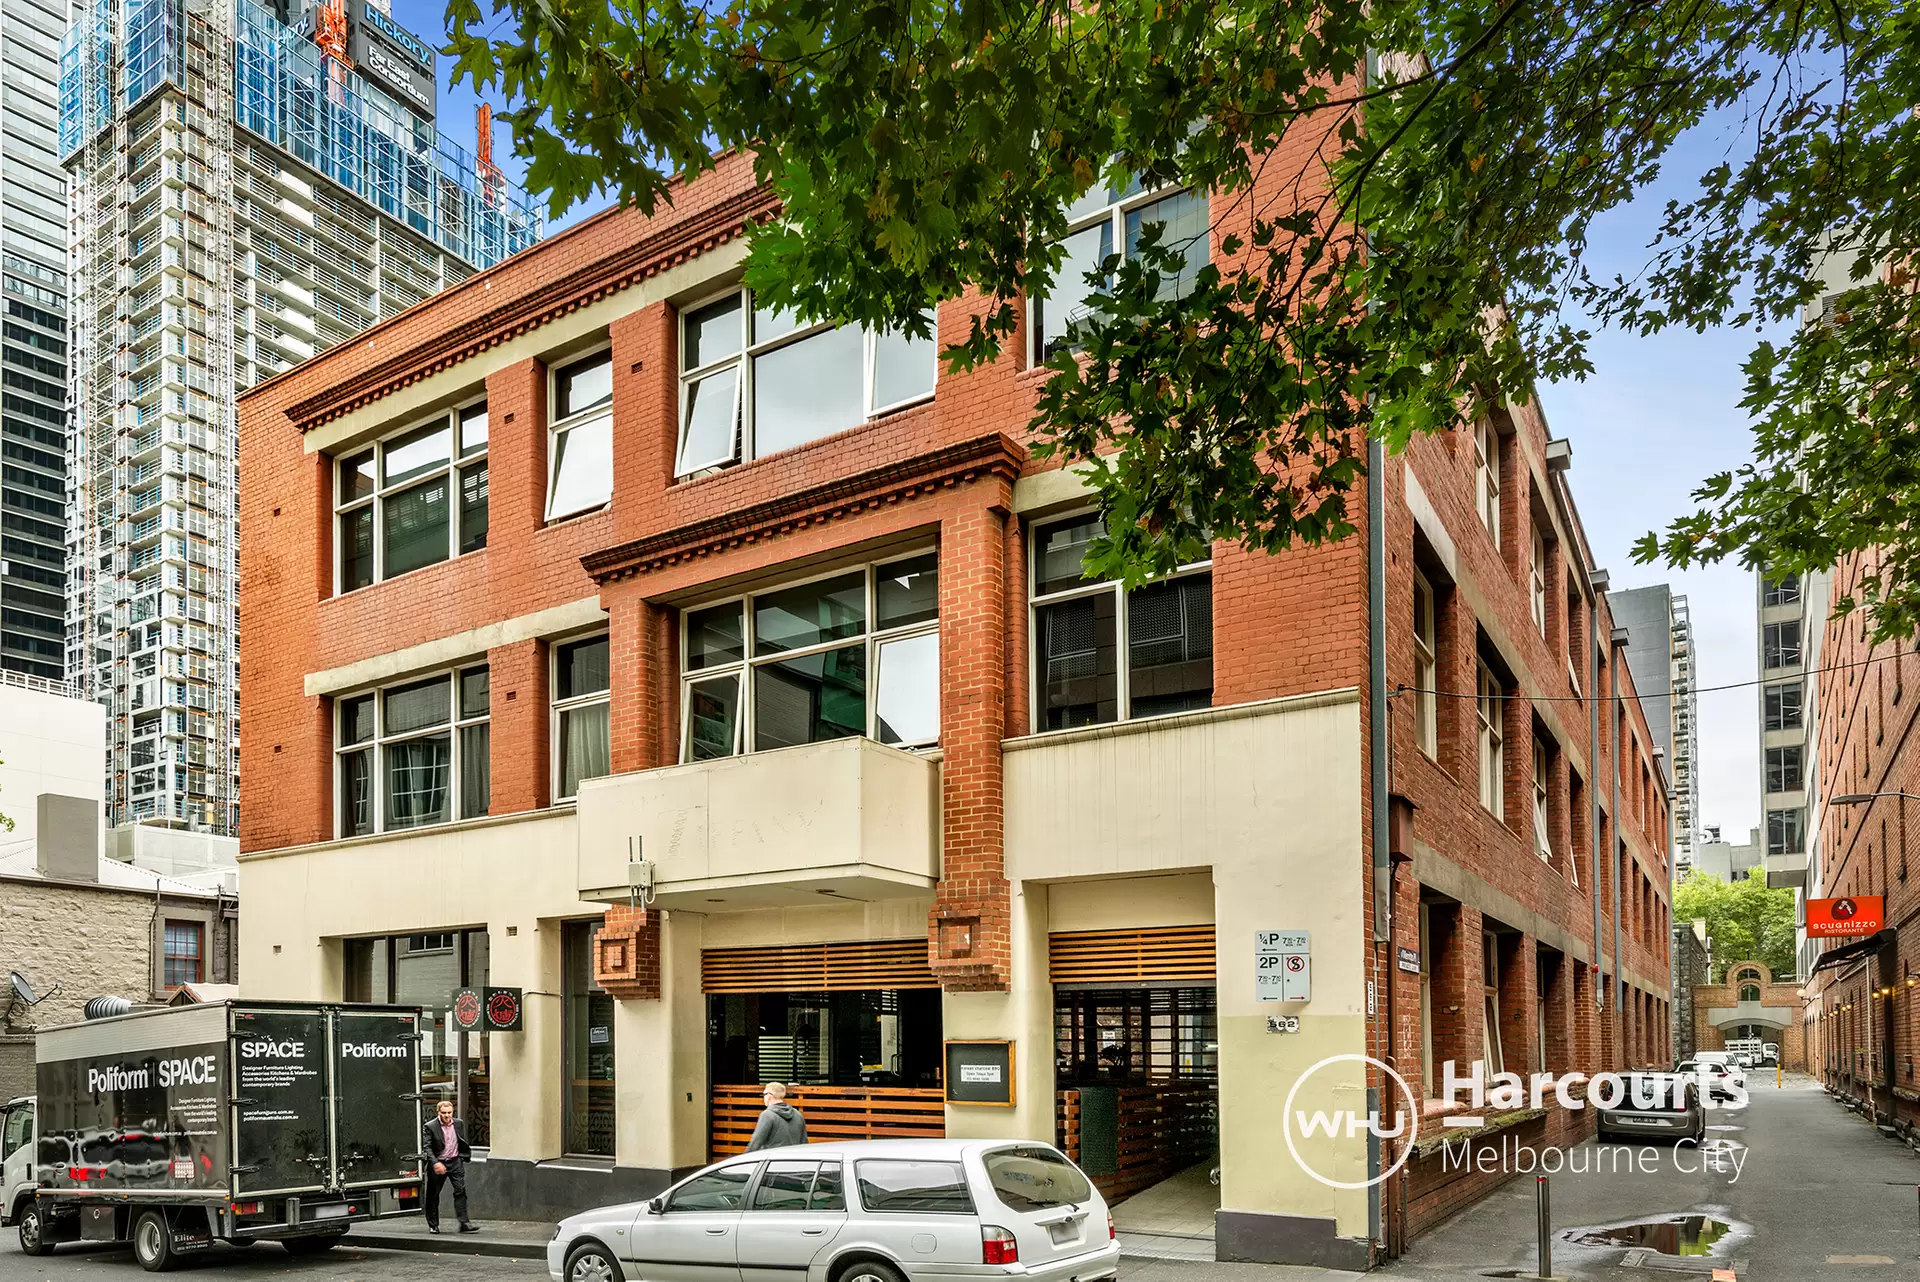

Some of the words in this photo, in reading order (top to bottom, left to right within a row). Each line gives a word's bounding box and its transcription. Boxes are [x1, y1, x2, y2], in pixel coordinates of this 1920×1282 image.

[365, 3, 432, 67] Hickory.
[368, 44, 387, 64] Far
[387, 59, 411, 83] East
[368, 57, 430, 107] Consortium
[1259, 957, 1279, 969] 2P
[241, 1041, 305, 1058] SPACE
[342, 1043, 407, 1058] Poliform
[88, 1062, 149, 1093] Poliform
[158, 1055, 217, 1088] SPACE
[174, 1234, 195, 1242] Elite
